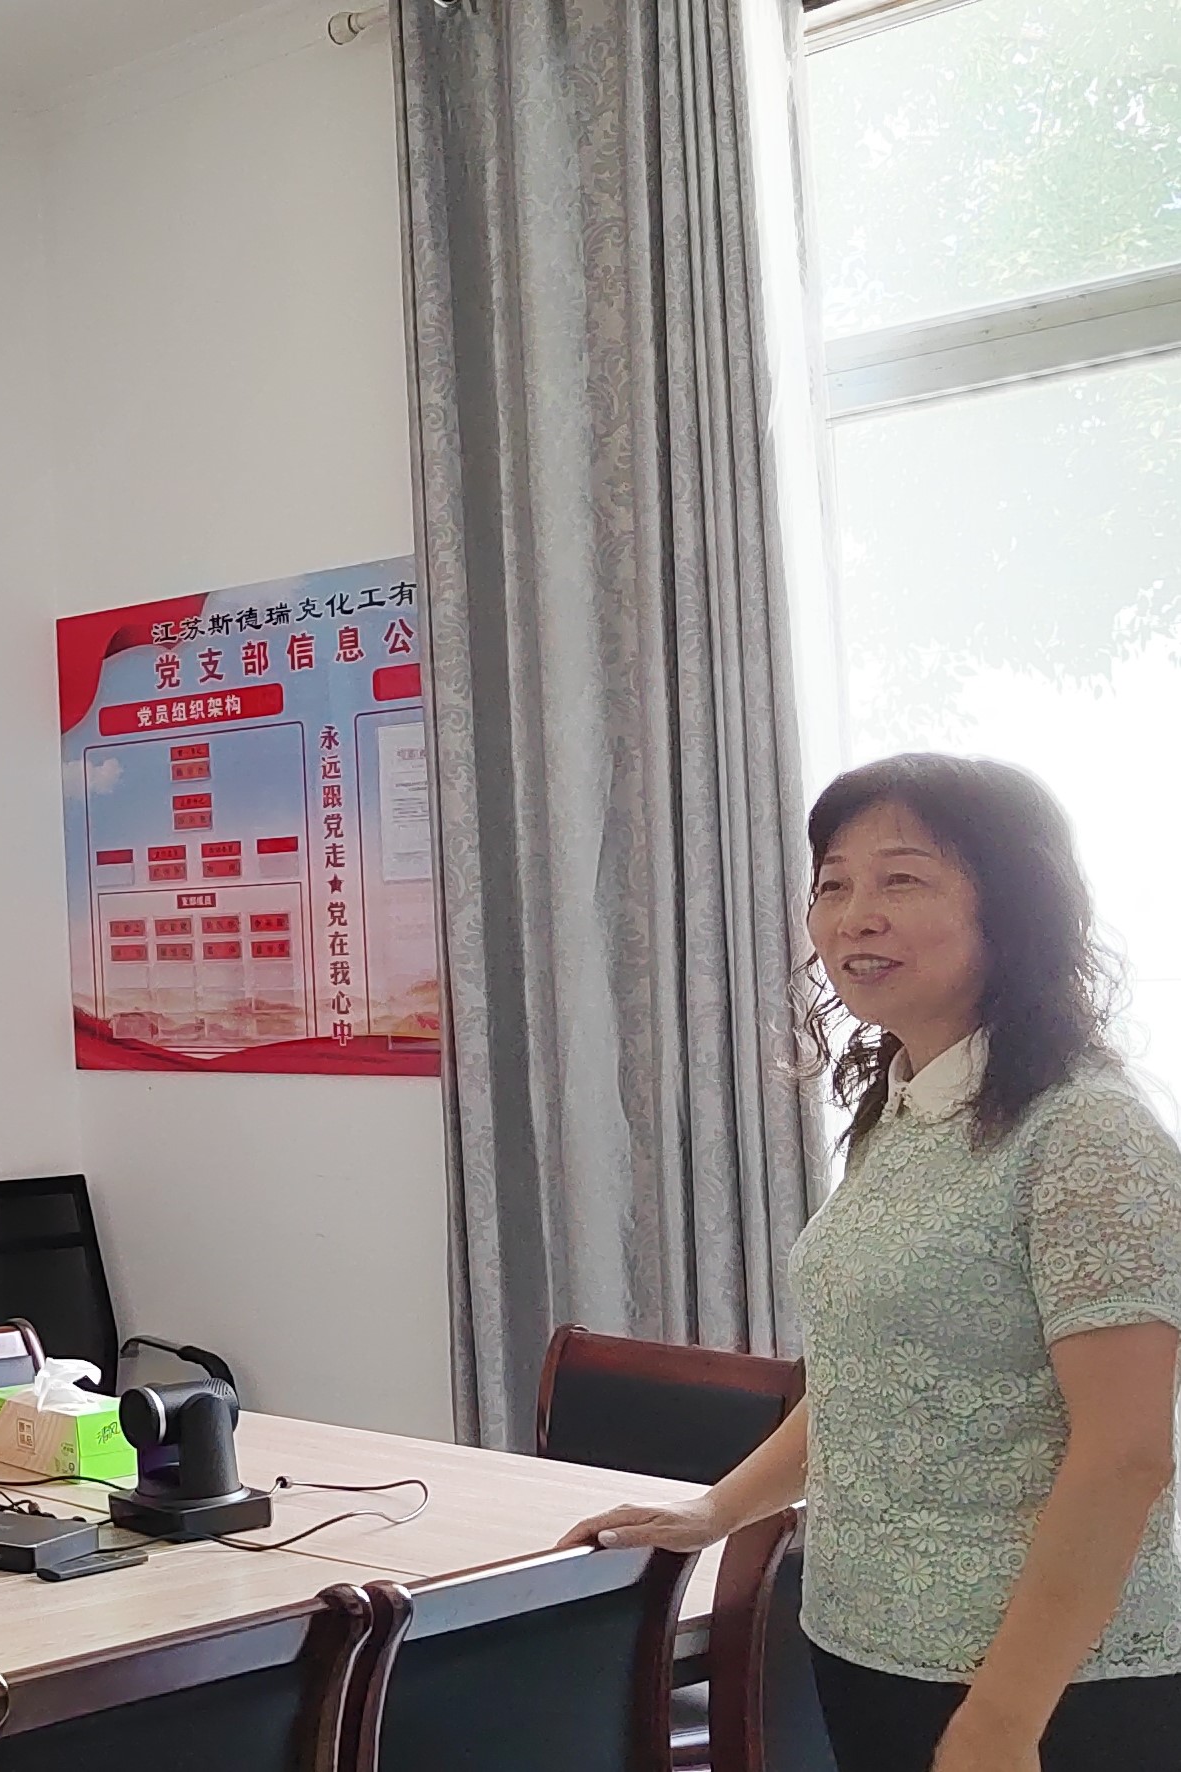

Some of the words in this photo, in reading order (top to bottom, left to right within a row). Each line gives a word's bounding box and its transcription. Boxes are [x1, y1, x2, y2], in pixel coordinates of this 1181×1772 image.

[151, 581, 417, 644] 江苏斯德瑞克化工有
[155, 618, 415, 689] 党支部信息公
[136, 695, 242, 728] 党员组织架构
[319, 725, 346, 869] 永远跟党走
[327, 901, 354, 1047] 党在我心中
